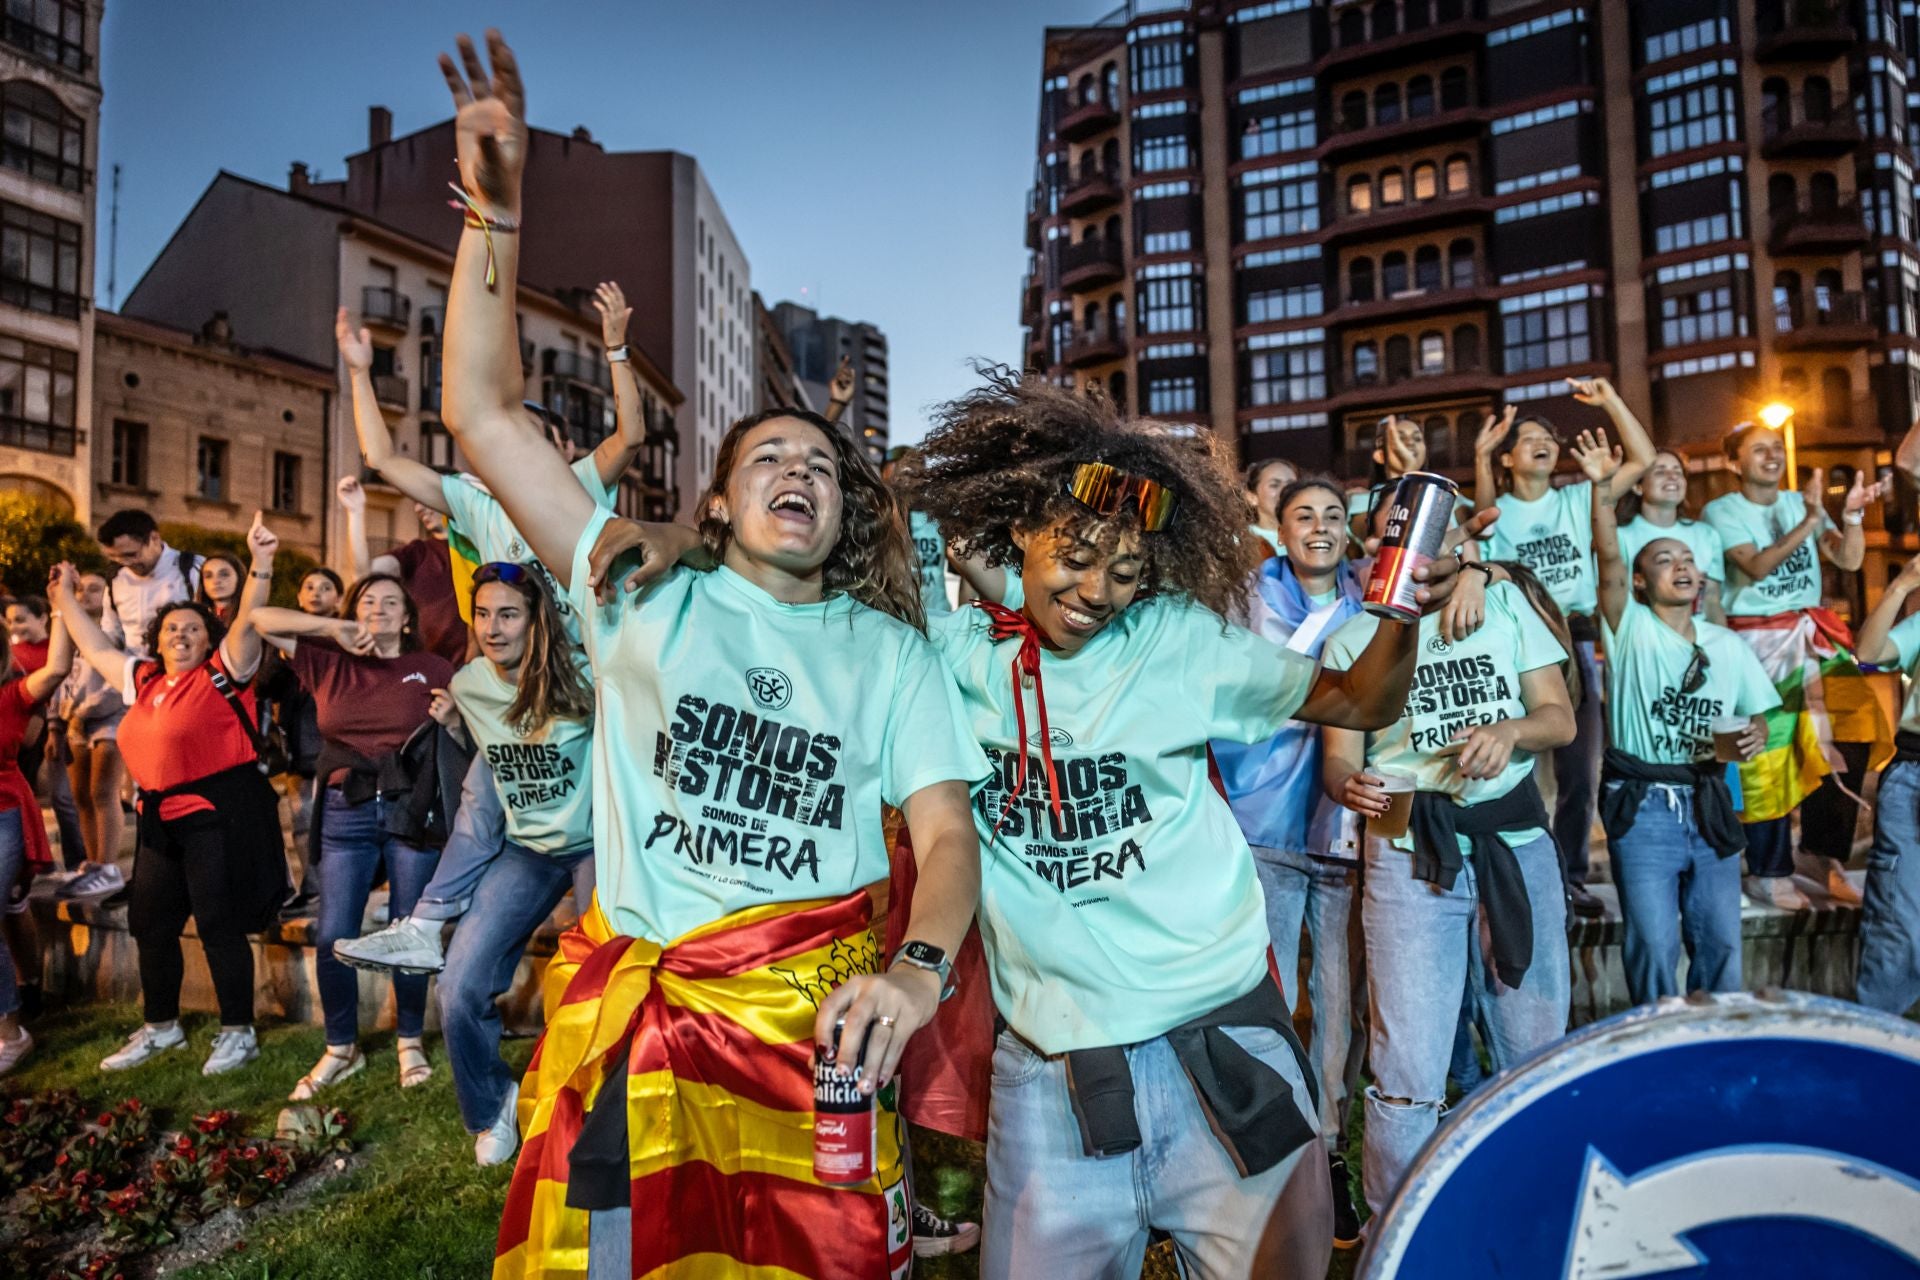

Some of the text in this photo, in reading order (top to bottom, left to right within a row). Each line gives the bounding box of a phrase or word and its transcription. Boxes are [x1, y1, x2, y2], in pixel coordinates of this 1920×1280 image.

[1516, 533, 1572, 557] SOMOS
[1401, 676, 1511, 718] ISTORIA
[1439, 708, 1476, 721] SOMOS DE
[670, 694, 841, 781] SOMOS
[487, 743, 561, 764] SOMOS
[506, 778, 577, 810] RIMERA
[653, 730, 846, 830] HISTORIA
[702, 805, 769, 833] SOMOS DE
[644, 810, 821, 883] PRIMERA
[1025, 844, 1088, 858] SOMOS DE
[814, 1083, 862, 1104] alicia
